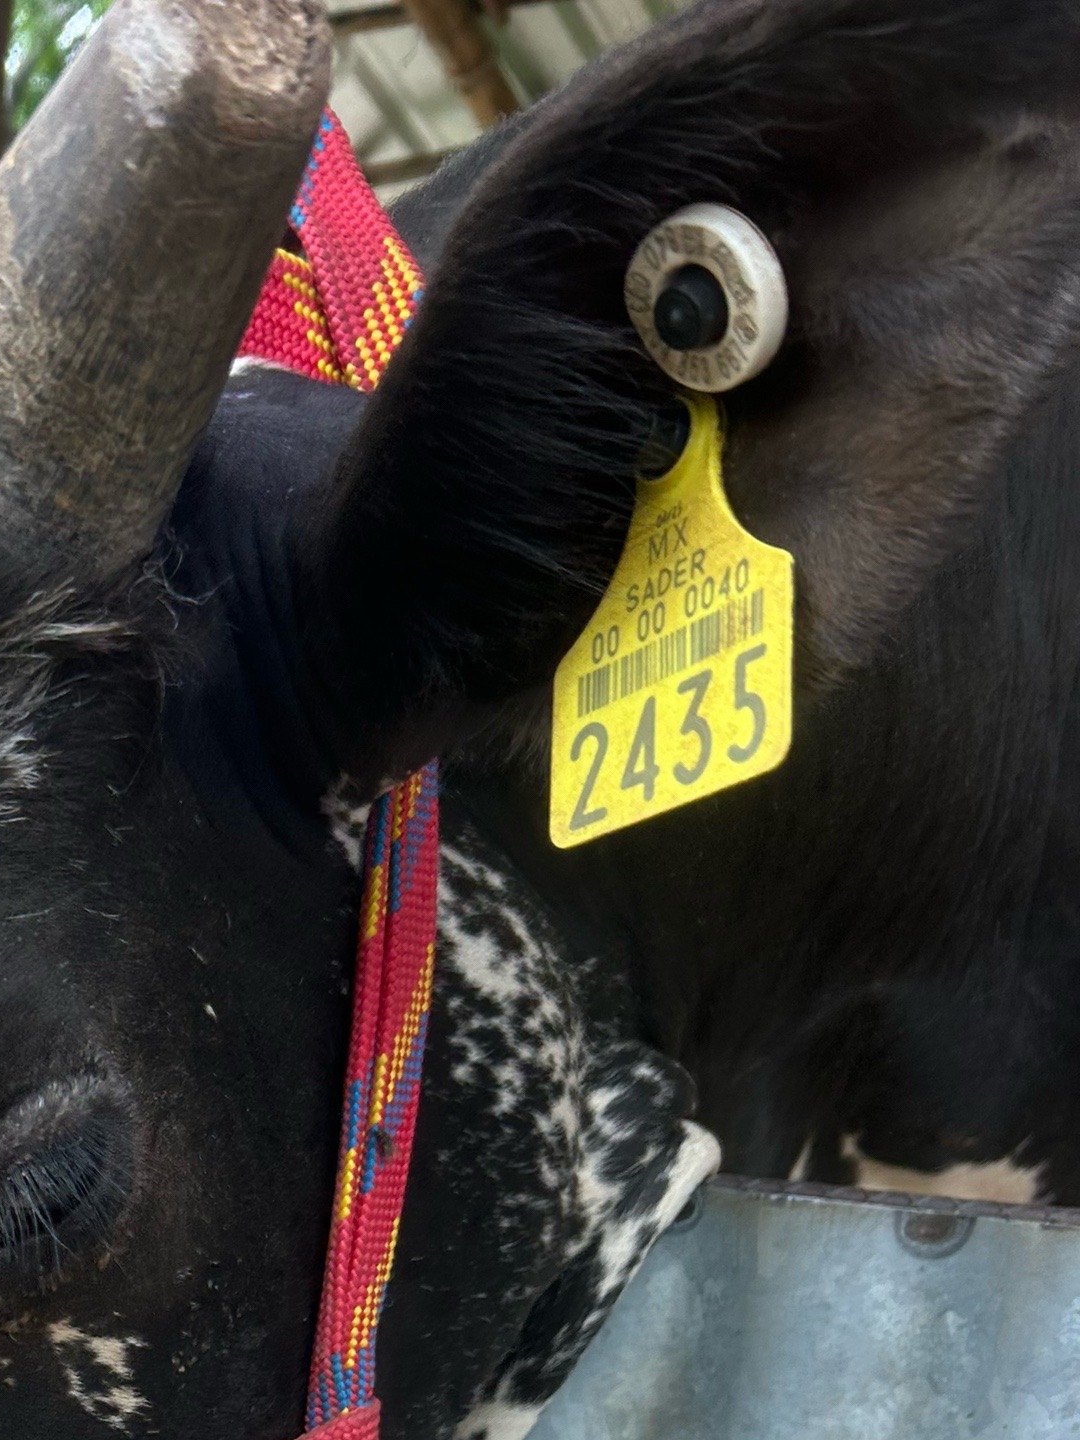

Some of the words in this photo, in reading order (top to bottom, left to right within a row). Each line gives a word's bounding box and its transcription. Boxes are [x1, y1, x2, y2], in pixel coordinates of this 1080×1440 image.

[626, 548, 705, 613] SADER
[648, 517, 688, 565] MX
[591, 625, 619, 665] 00
[637, 603, 665, 643] 00
[684, 558, 749, 618] 0040
[569, 642, 768, 831] 2435
